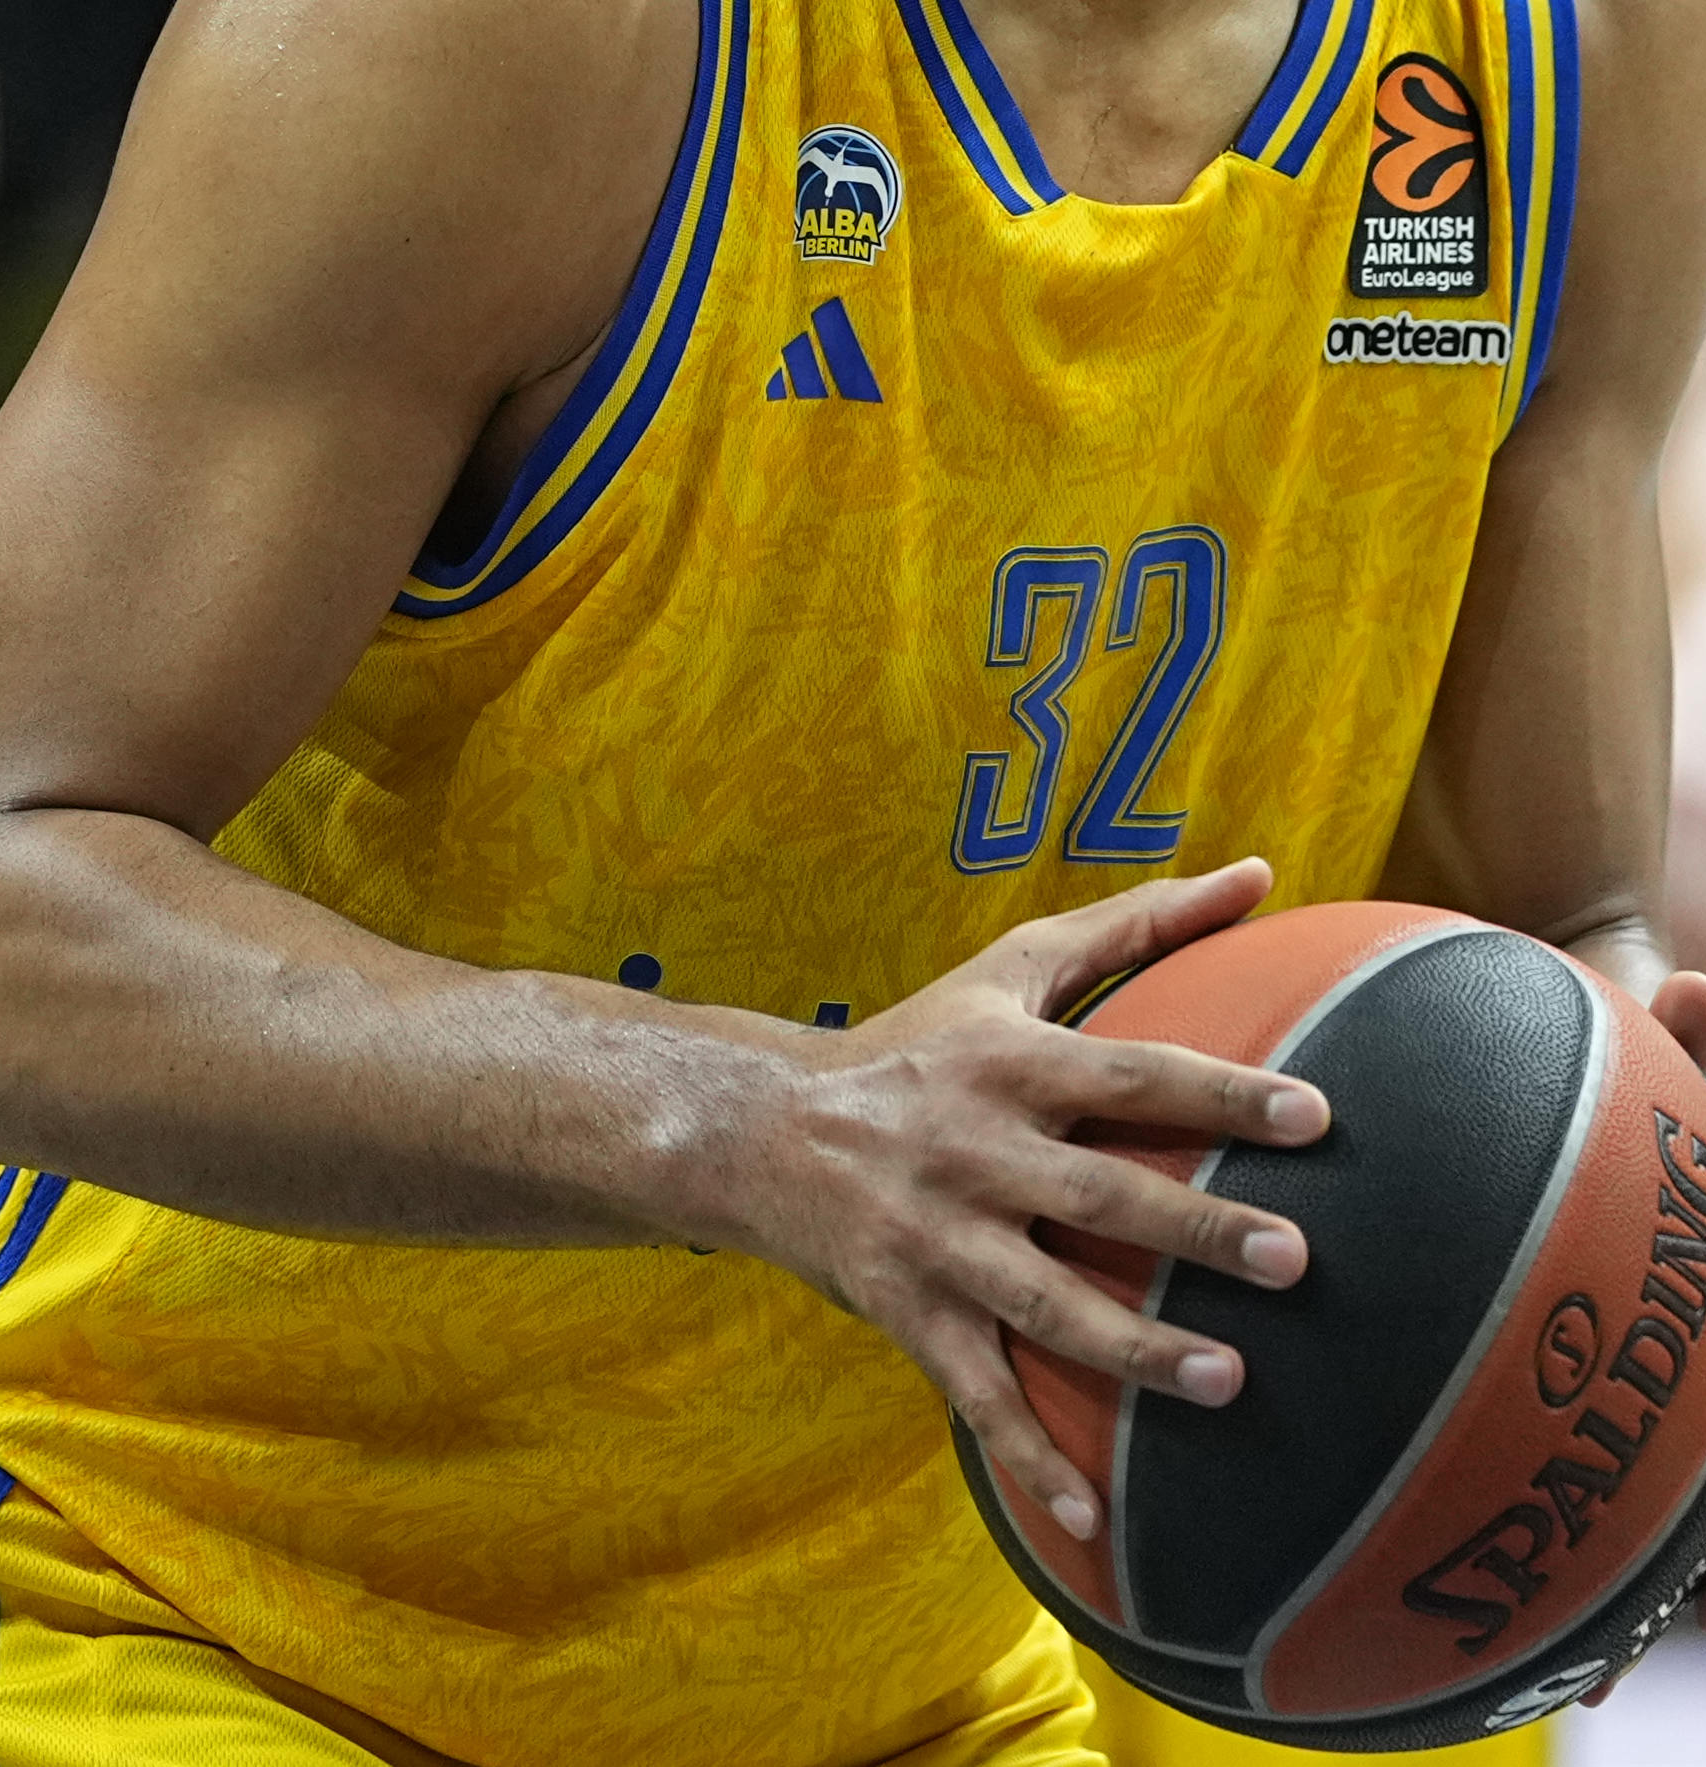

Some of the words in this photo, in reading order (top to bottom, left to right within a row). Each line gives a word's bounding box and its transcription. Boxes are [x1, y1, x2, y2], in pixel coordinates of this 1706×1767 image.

[798, 207, 879, 243] ALBA
[1363, 215, 1475, 241] TURKISH
[805, 237, 870, 259] BERLIN
[1362, 241, 1474, 266] AIRLINES
[1360, 267, 1475, 291] EuroLeague
[1326, 316, 1506, 360] oneteam
[950, 524, 1229, 876] 32
